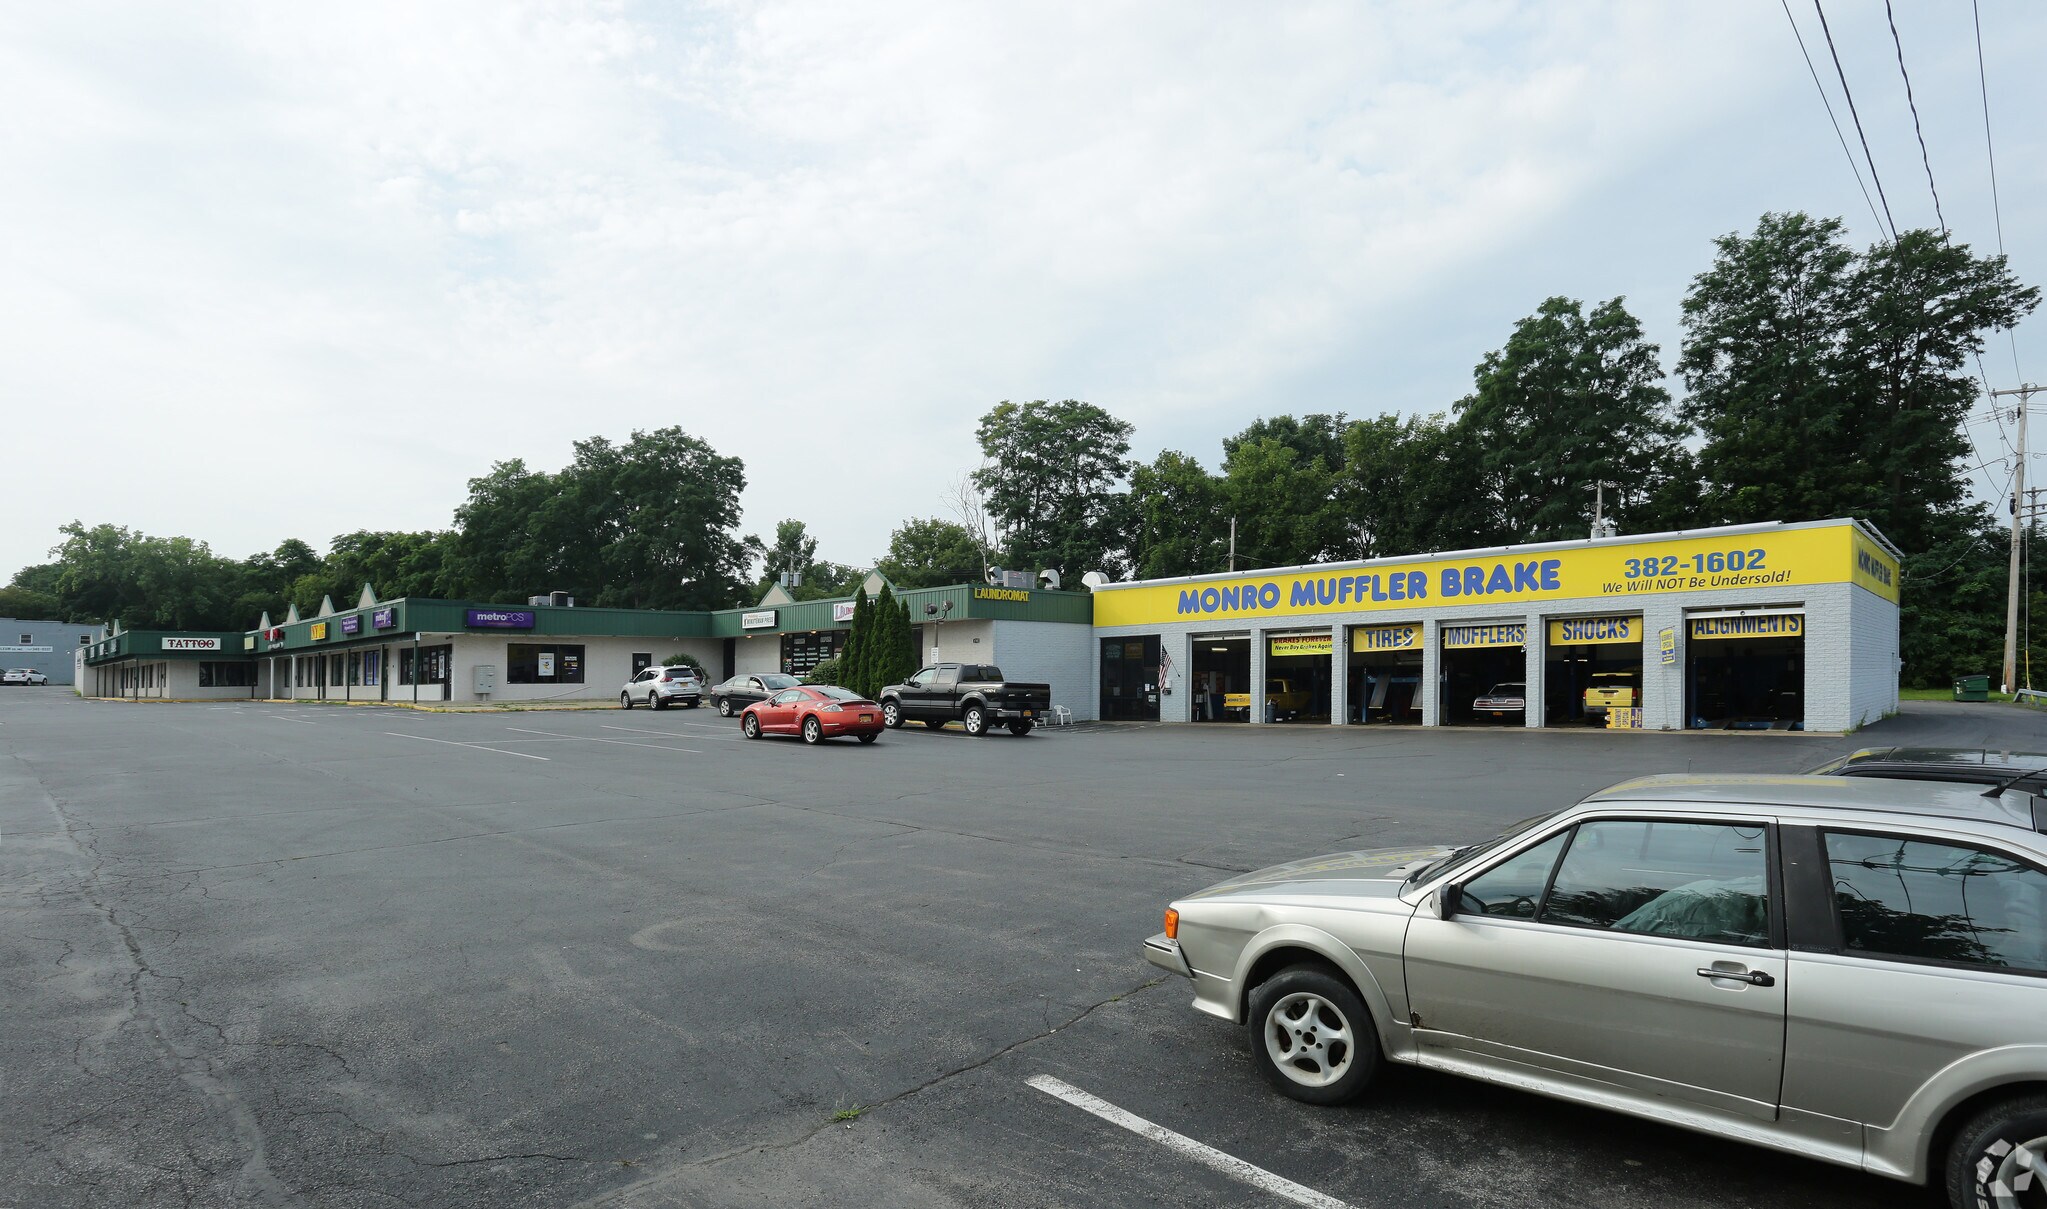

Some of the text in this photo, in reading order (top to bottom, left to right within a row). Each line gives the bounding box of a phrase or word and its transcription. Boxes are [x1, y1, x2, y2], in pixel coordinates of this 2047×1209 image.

[1624, 548, 1766, 578] 382-1602
[1177, 559, 1562, 615] MONRO MUFFLER BRAKE
[1602, 569, 1791, 594] We Will NOT Be Undersold!
[974, 587, 1029, 602] LAUNDROMAT
[477, 612, 524, 622] metroPCS
[1695, 615, 1799, 635] ALIGNMENTS
[1365, 628, 1413, 648] TIRES
[1448, 624, 1526, 645] MUFFLERS
[1562, 616, 1629, 641] SHOCKS
[168, 639, 215, 648] TATTOO
